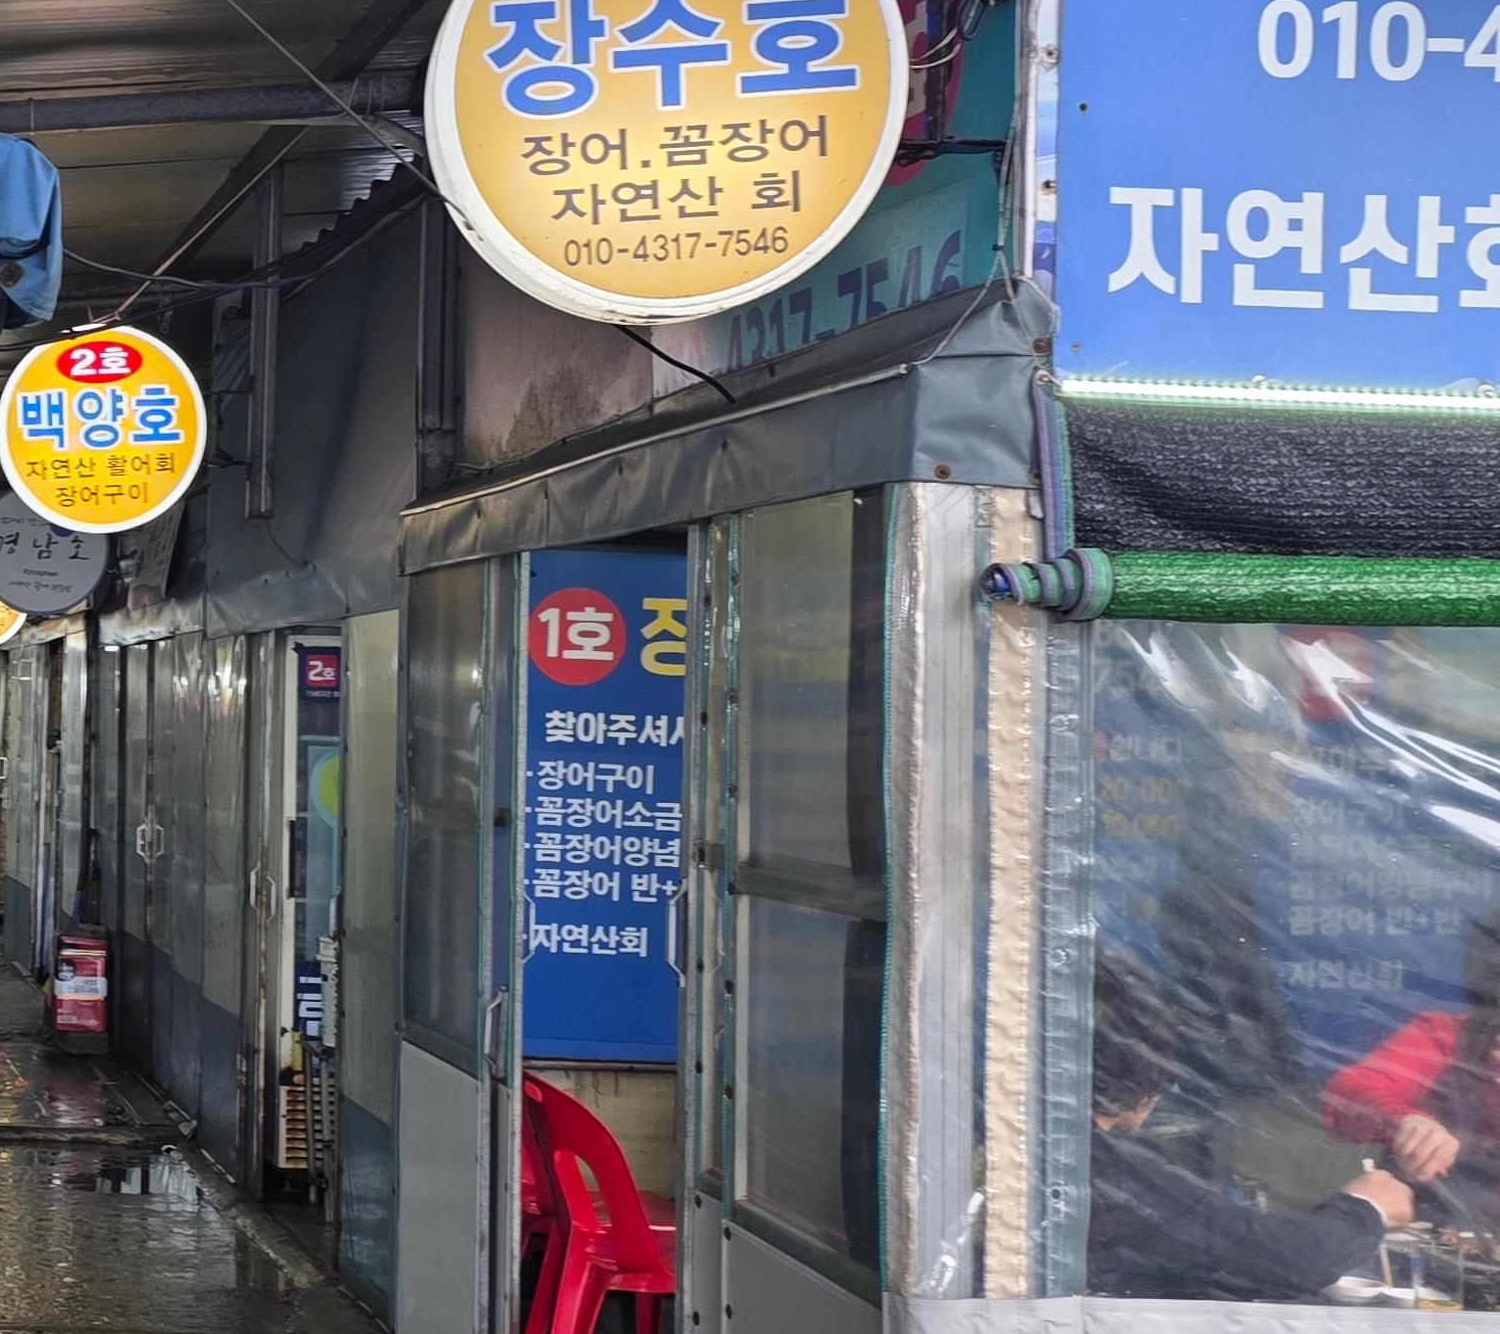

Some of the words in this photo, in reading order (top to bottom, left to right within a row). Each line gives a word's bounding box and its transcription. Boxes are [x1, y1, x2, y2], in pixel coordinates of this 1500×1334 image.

[551, 175, 724, 225] 자연산
[750, 170, 802, 213] 회
[564, 226, 789, 267] 010-4317-7546
[70, 347, 131, 376] 2호
[17, 386, 184, 450] 백양호
[26, 457, 96, 480] 자연산
[107, 452, 176, 477] 활어회
[56, 482, 148, 508] 장어구이
[538, 607, 614, 663] 1호
[537, 762, 654, 795] 장어구이
[534, 796, 683, 831] 꼼장어소금
[533, 833, 681, 868] 꼼장어양념
[532, 870, 620, 902] 꼼장어
[532, 923, 648, 957] 자연산회
